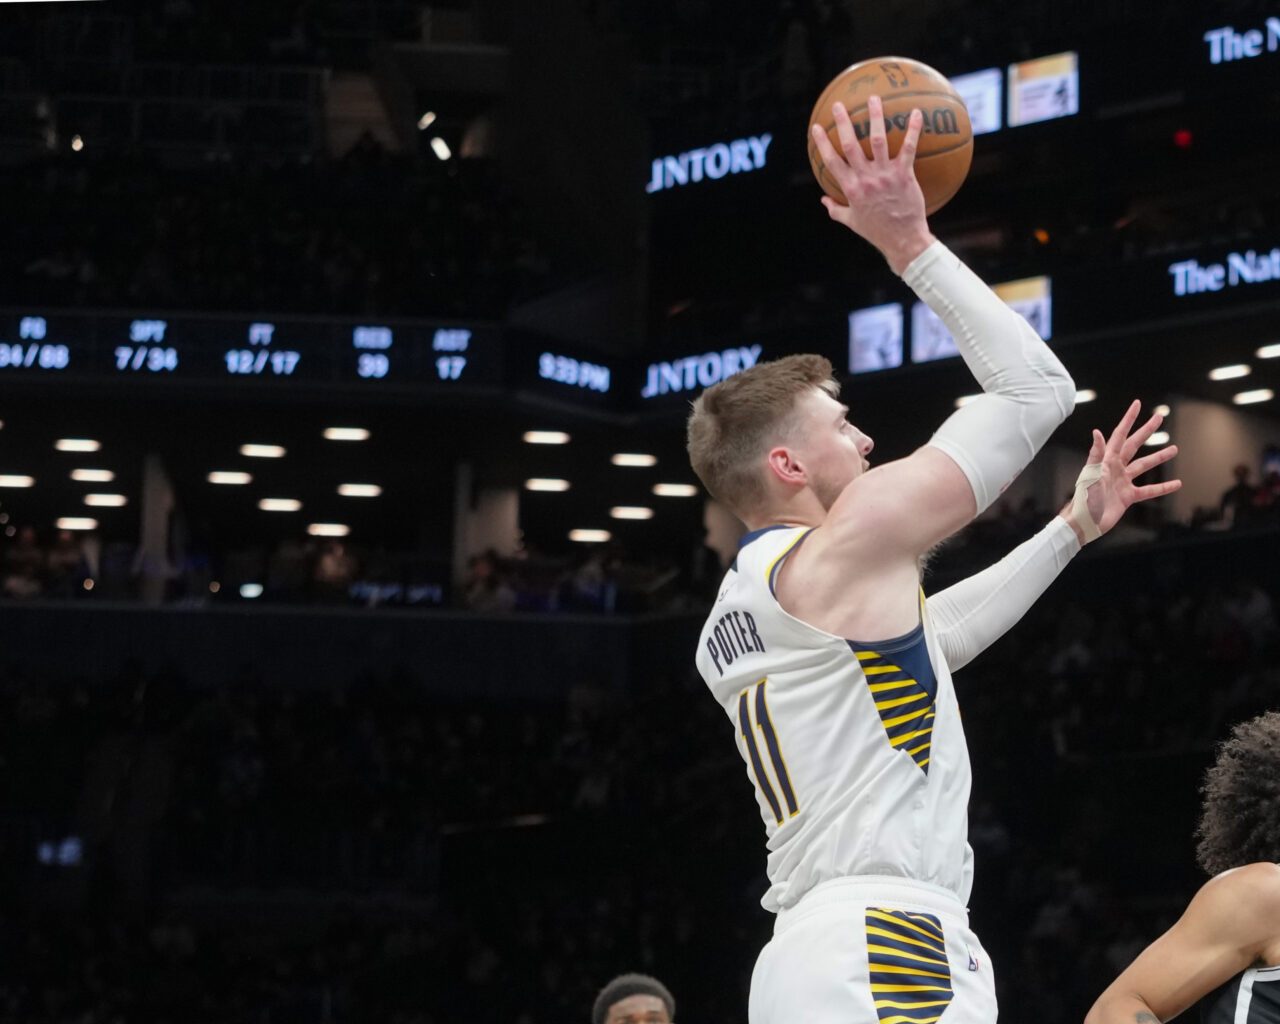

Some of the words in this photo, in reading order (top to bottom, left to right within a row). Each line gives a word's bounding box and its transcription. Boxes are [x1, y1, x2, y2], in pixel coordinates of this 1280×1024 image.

[1204, 26, 1263, 65] The
[1169, 260, 1225, 297] The
[436, 356, 467, 379] 17
[706, 609, 766, 678] POTTER
[737, 676, 800, 827] 11
